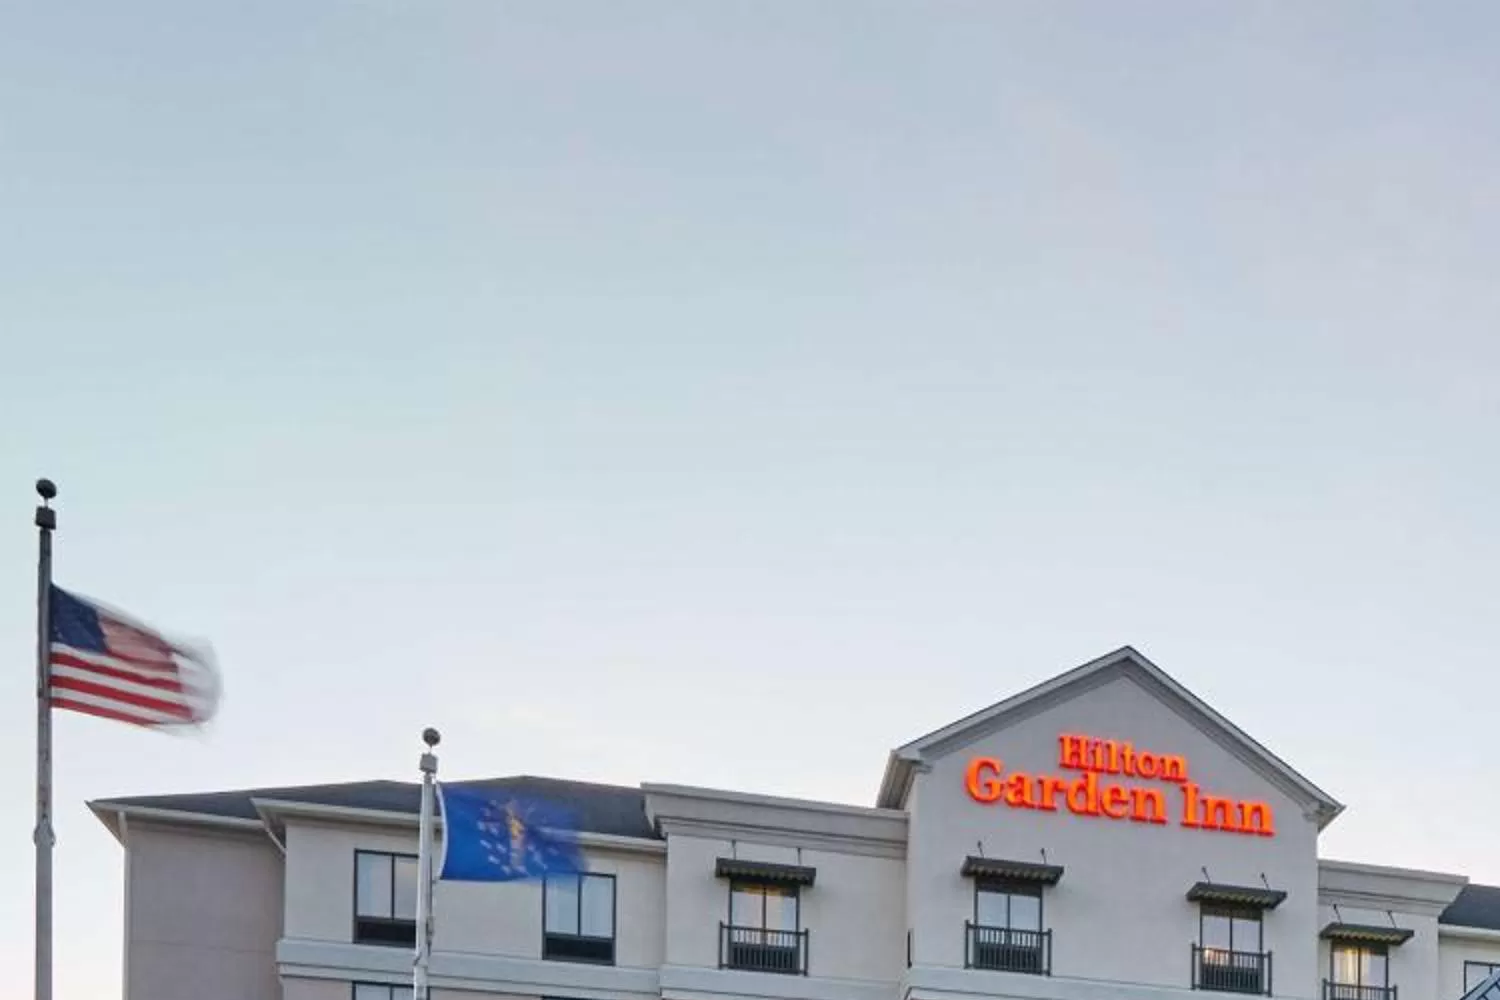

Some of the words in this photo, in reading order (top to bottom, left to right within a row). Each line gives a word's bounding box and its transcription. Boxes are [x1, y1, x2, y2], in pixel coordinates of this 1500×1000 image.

[1058, 734, 1188, 782] Hilton
[965, 757, 1167, 824] Garden
[1180, 781, 1275, 836] Inn
